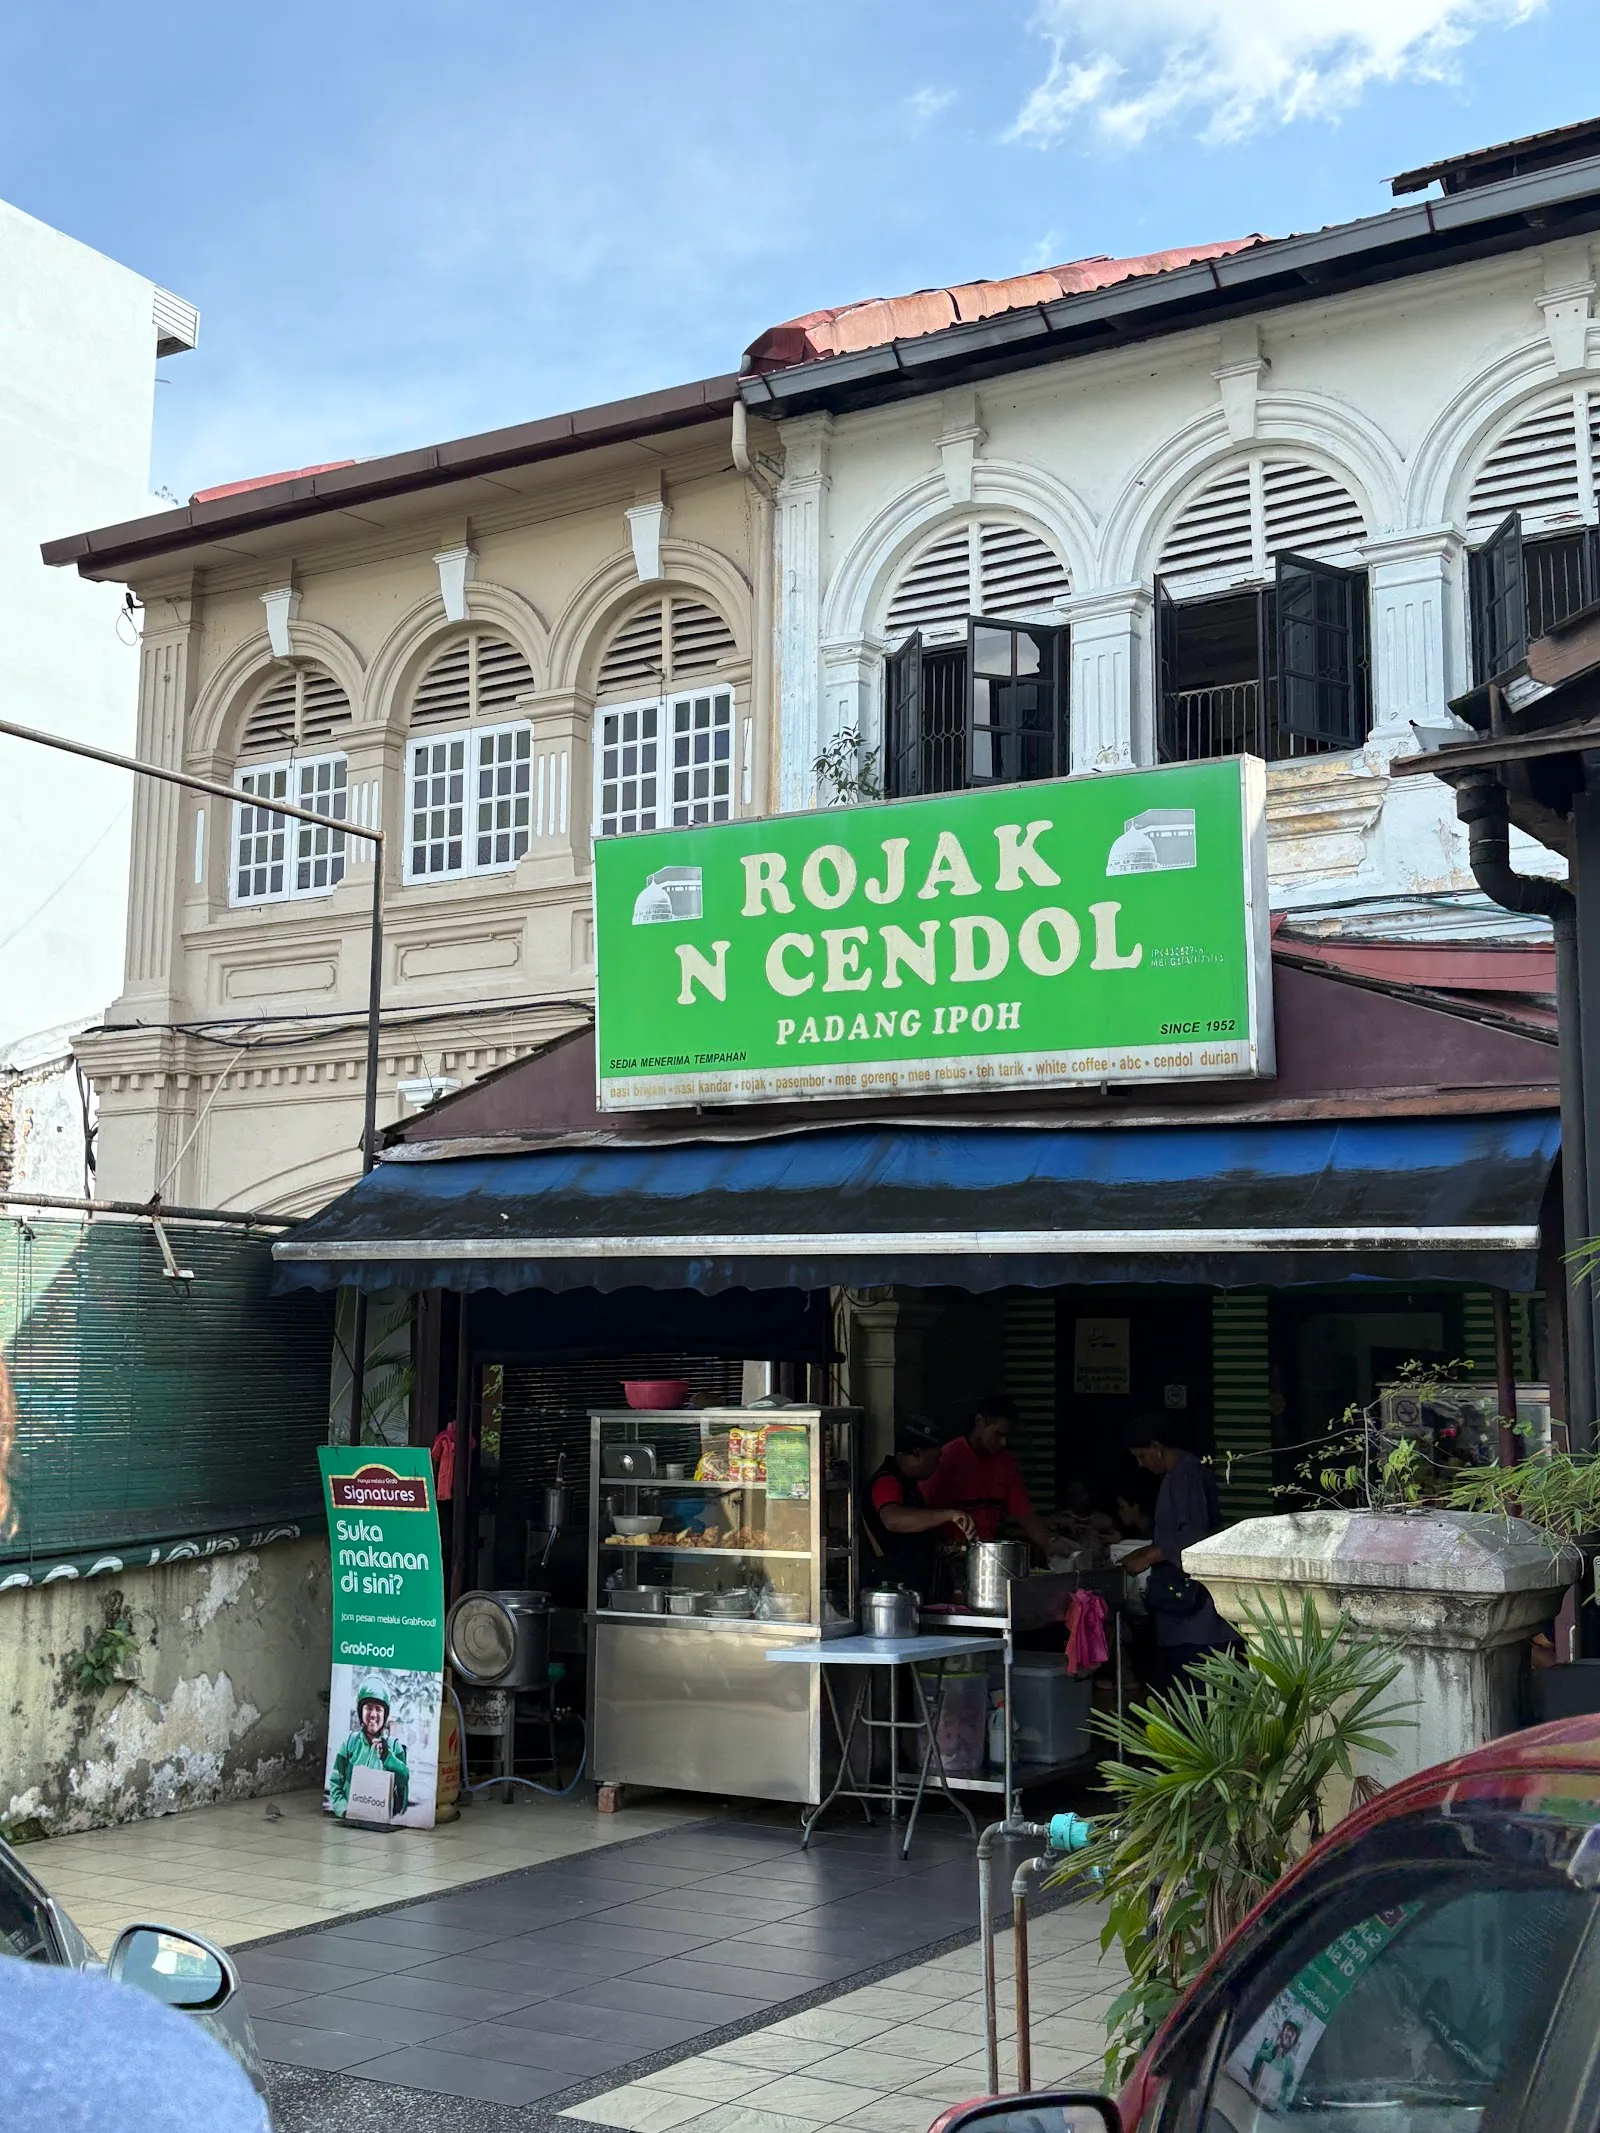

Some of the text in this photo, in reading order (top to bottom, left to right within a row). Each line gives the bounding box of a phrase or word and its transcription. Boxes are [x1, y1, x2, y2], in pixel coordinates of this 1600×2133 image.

[740, 820, 1062, 917] ROJAK
[675, 901, 1143, 1005] N CENDOL
[776, 1001, 1022, 1045] PADANG IPOH
[1160, 1019, 1236, 1035] SINCE 1952
[609, 1051, 747, 1070] SEDIA MENERIMA TEMPAHAN
[610, 1084, 630, 1098] nasi
[674, 1081, 695, 1096] nasi
[699, 1079, 732, 1094] kandar
[741, 1077, 766, 1095] rojak
[776, 1073, 826, 1090] pasembor
[835, 1074, 857, 1086] mee
[861, 1071, 899, 1088] goreng
[908, 1069, 931, 1082] mee
[935, 1066, 966, 1081] rebus
[976, 1064, 995, 1078] teh
[999, 1061, 1025, 1077] tarik
[1036, 1059, 1067, 1075] white
[1071, 1056, 1108, 1073] coffee
[1119, 1055, 1142, 1070] abc
[1153, 1051, 1193, 1069] cendol
[1200, 1049, 1239, 1067] durian
[386, 1477, 399, 1485] Grab
[343, 1485, 416, 1504] Signatures
[336, 1519, 384, 1542] Suka
[339, 1545, 429, 1571] makanan
[340, 1570, 404, 1596] di sini?
[341, 1612, 437, 1628] Jom pesan melalui GrabFood!
[340, 1640, 395, 1658] GrabFood
[352, 1793, 386, 1808] GrabFood
